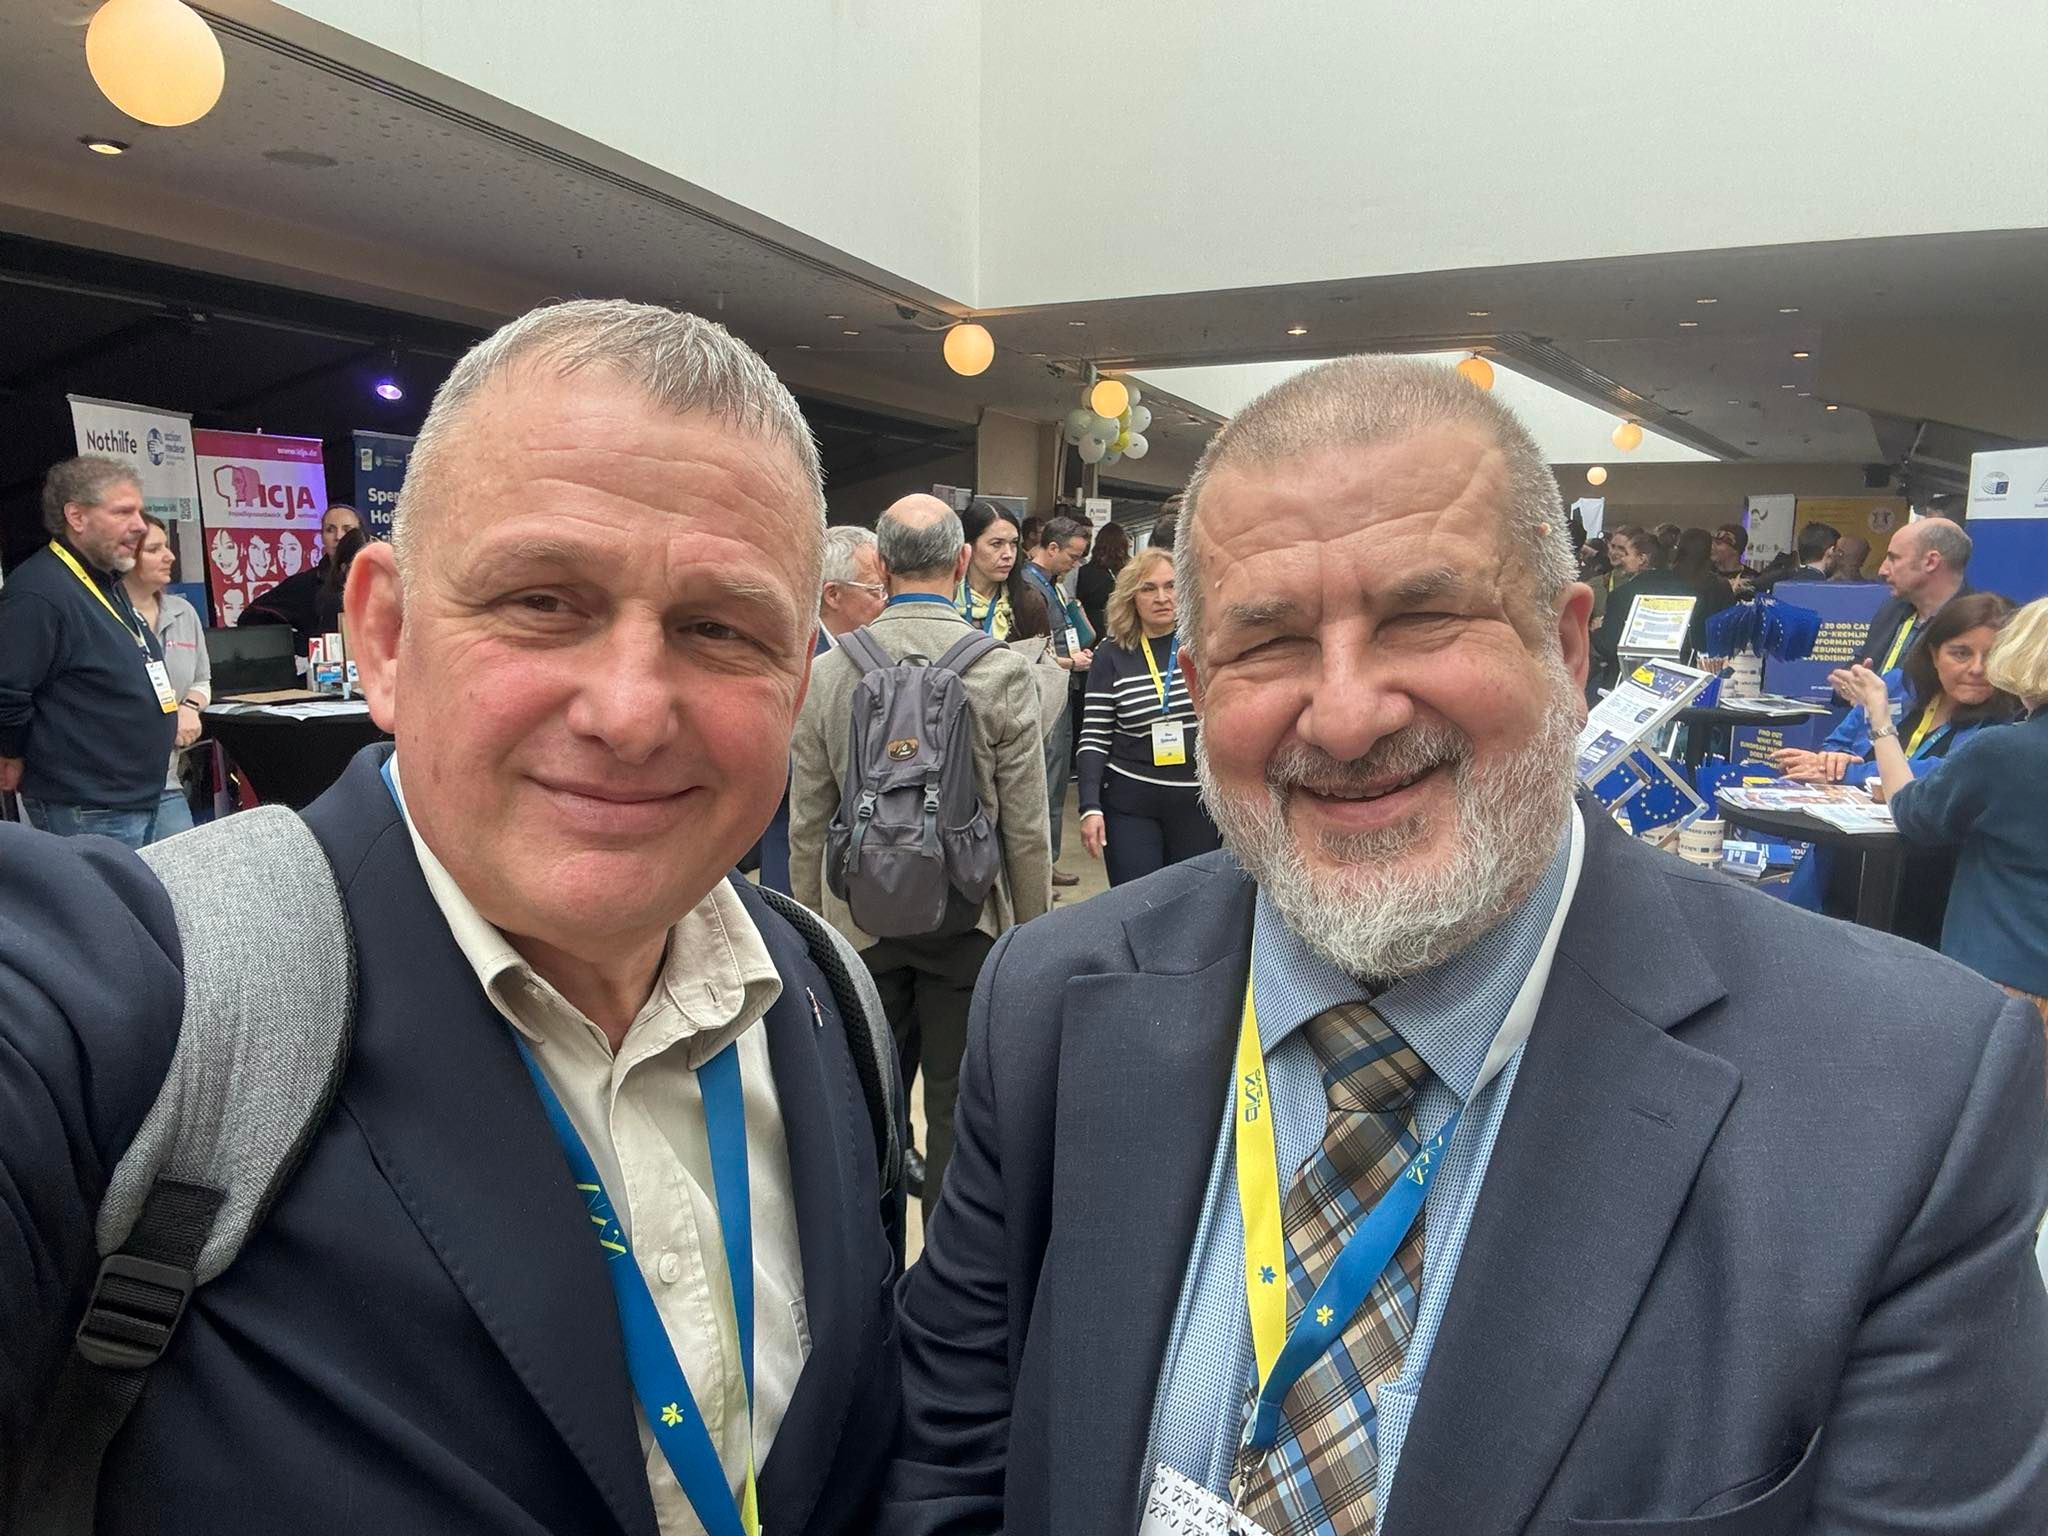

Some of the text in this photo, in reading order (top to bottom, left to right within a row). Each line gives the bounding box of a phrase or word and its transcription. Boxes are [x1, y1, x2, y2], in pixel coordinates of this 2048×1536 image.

[86, 428, 137, 455] Nothilfe
[258, 484, 316, 520] ICJA
[1835, 622, 1852, 630] 000
